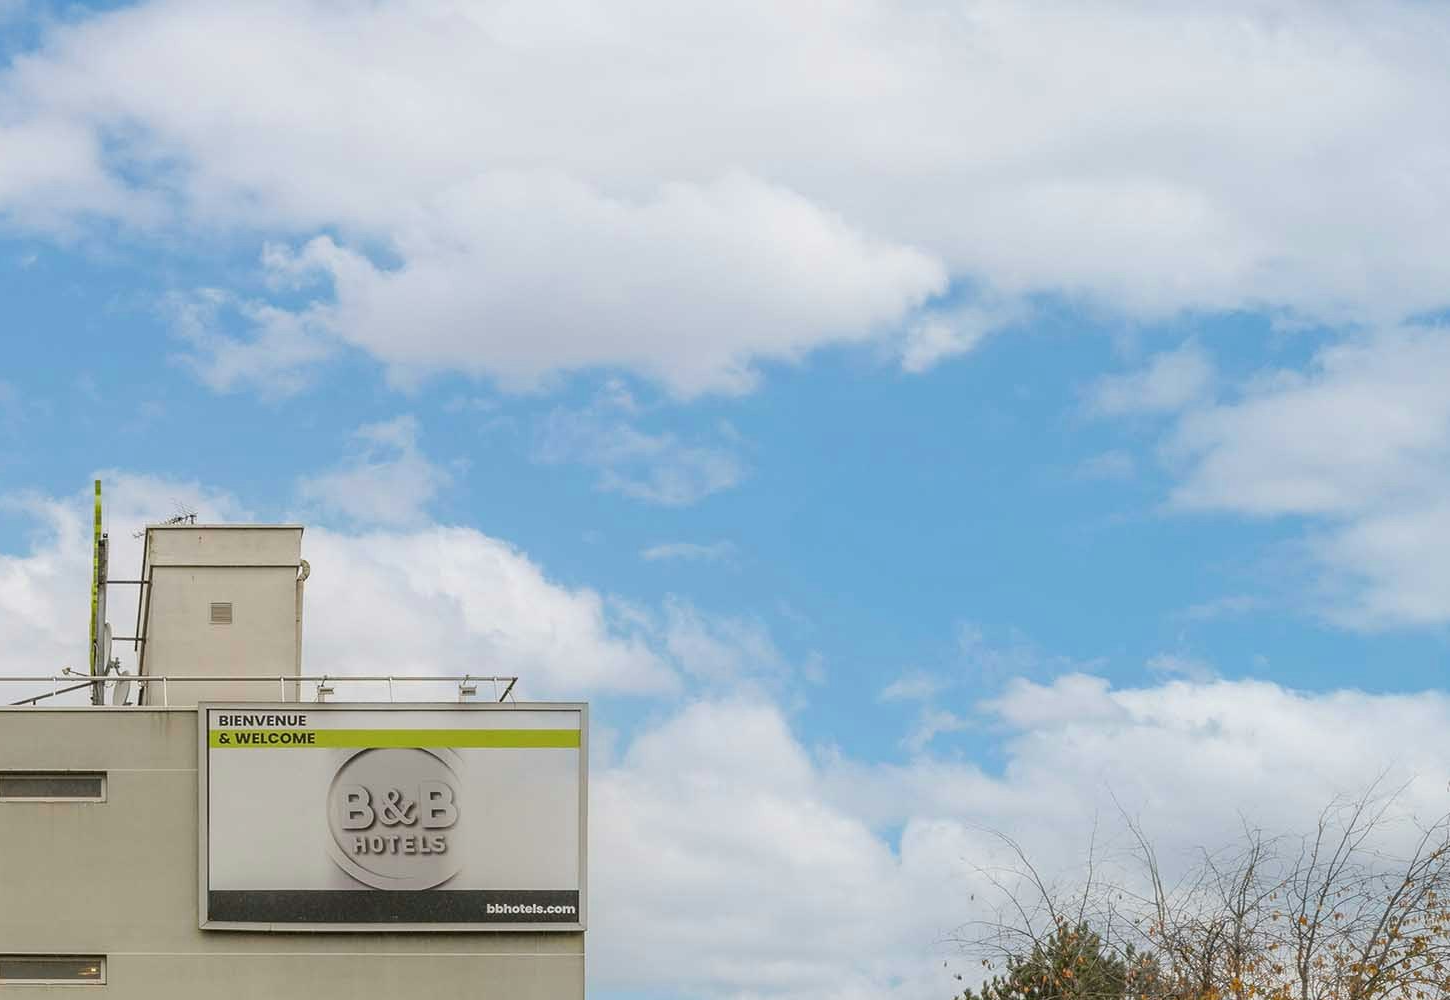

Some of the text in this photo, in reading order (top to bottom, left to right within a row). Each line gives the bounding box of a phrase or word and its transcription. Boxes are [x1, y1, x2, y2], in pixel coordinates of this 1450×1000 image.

[218, 715, 307, 727] BIENVENUE
[218, 732, 316, 745] & WELCOME
[341, 782, 459, 831] B&B
[353, 834, 448, 855] HOTELS
[486, 903, 576, 914] bbhotels.com
